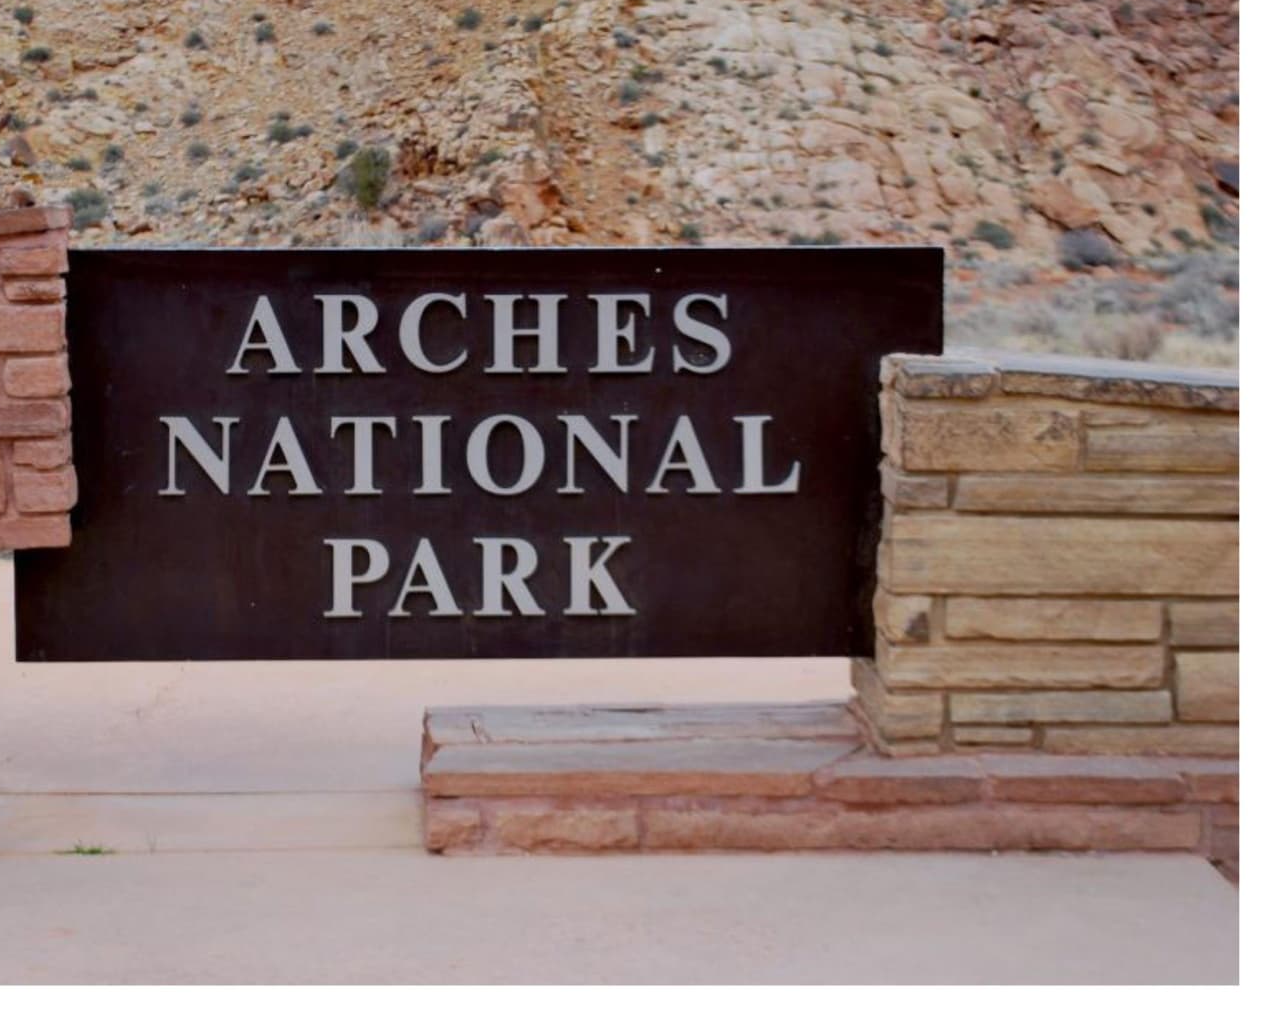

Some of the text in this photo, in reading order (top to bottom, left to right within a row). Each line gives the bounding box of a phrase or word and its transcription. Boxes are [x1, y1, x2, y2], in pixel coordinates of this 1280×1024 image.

[225, 291, 734, 376] ARCHES
[157, 413, 803, 498] NATIONAL
[322, 536, 638, 619] PARK
